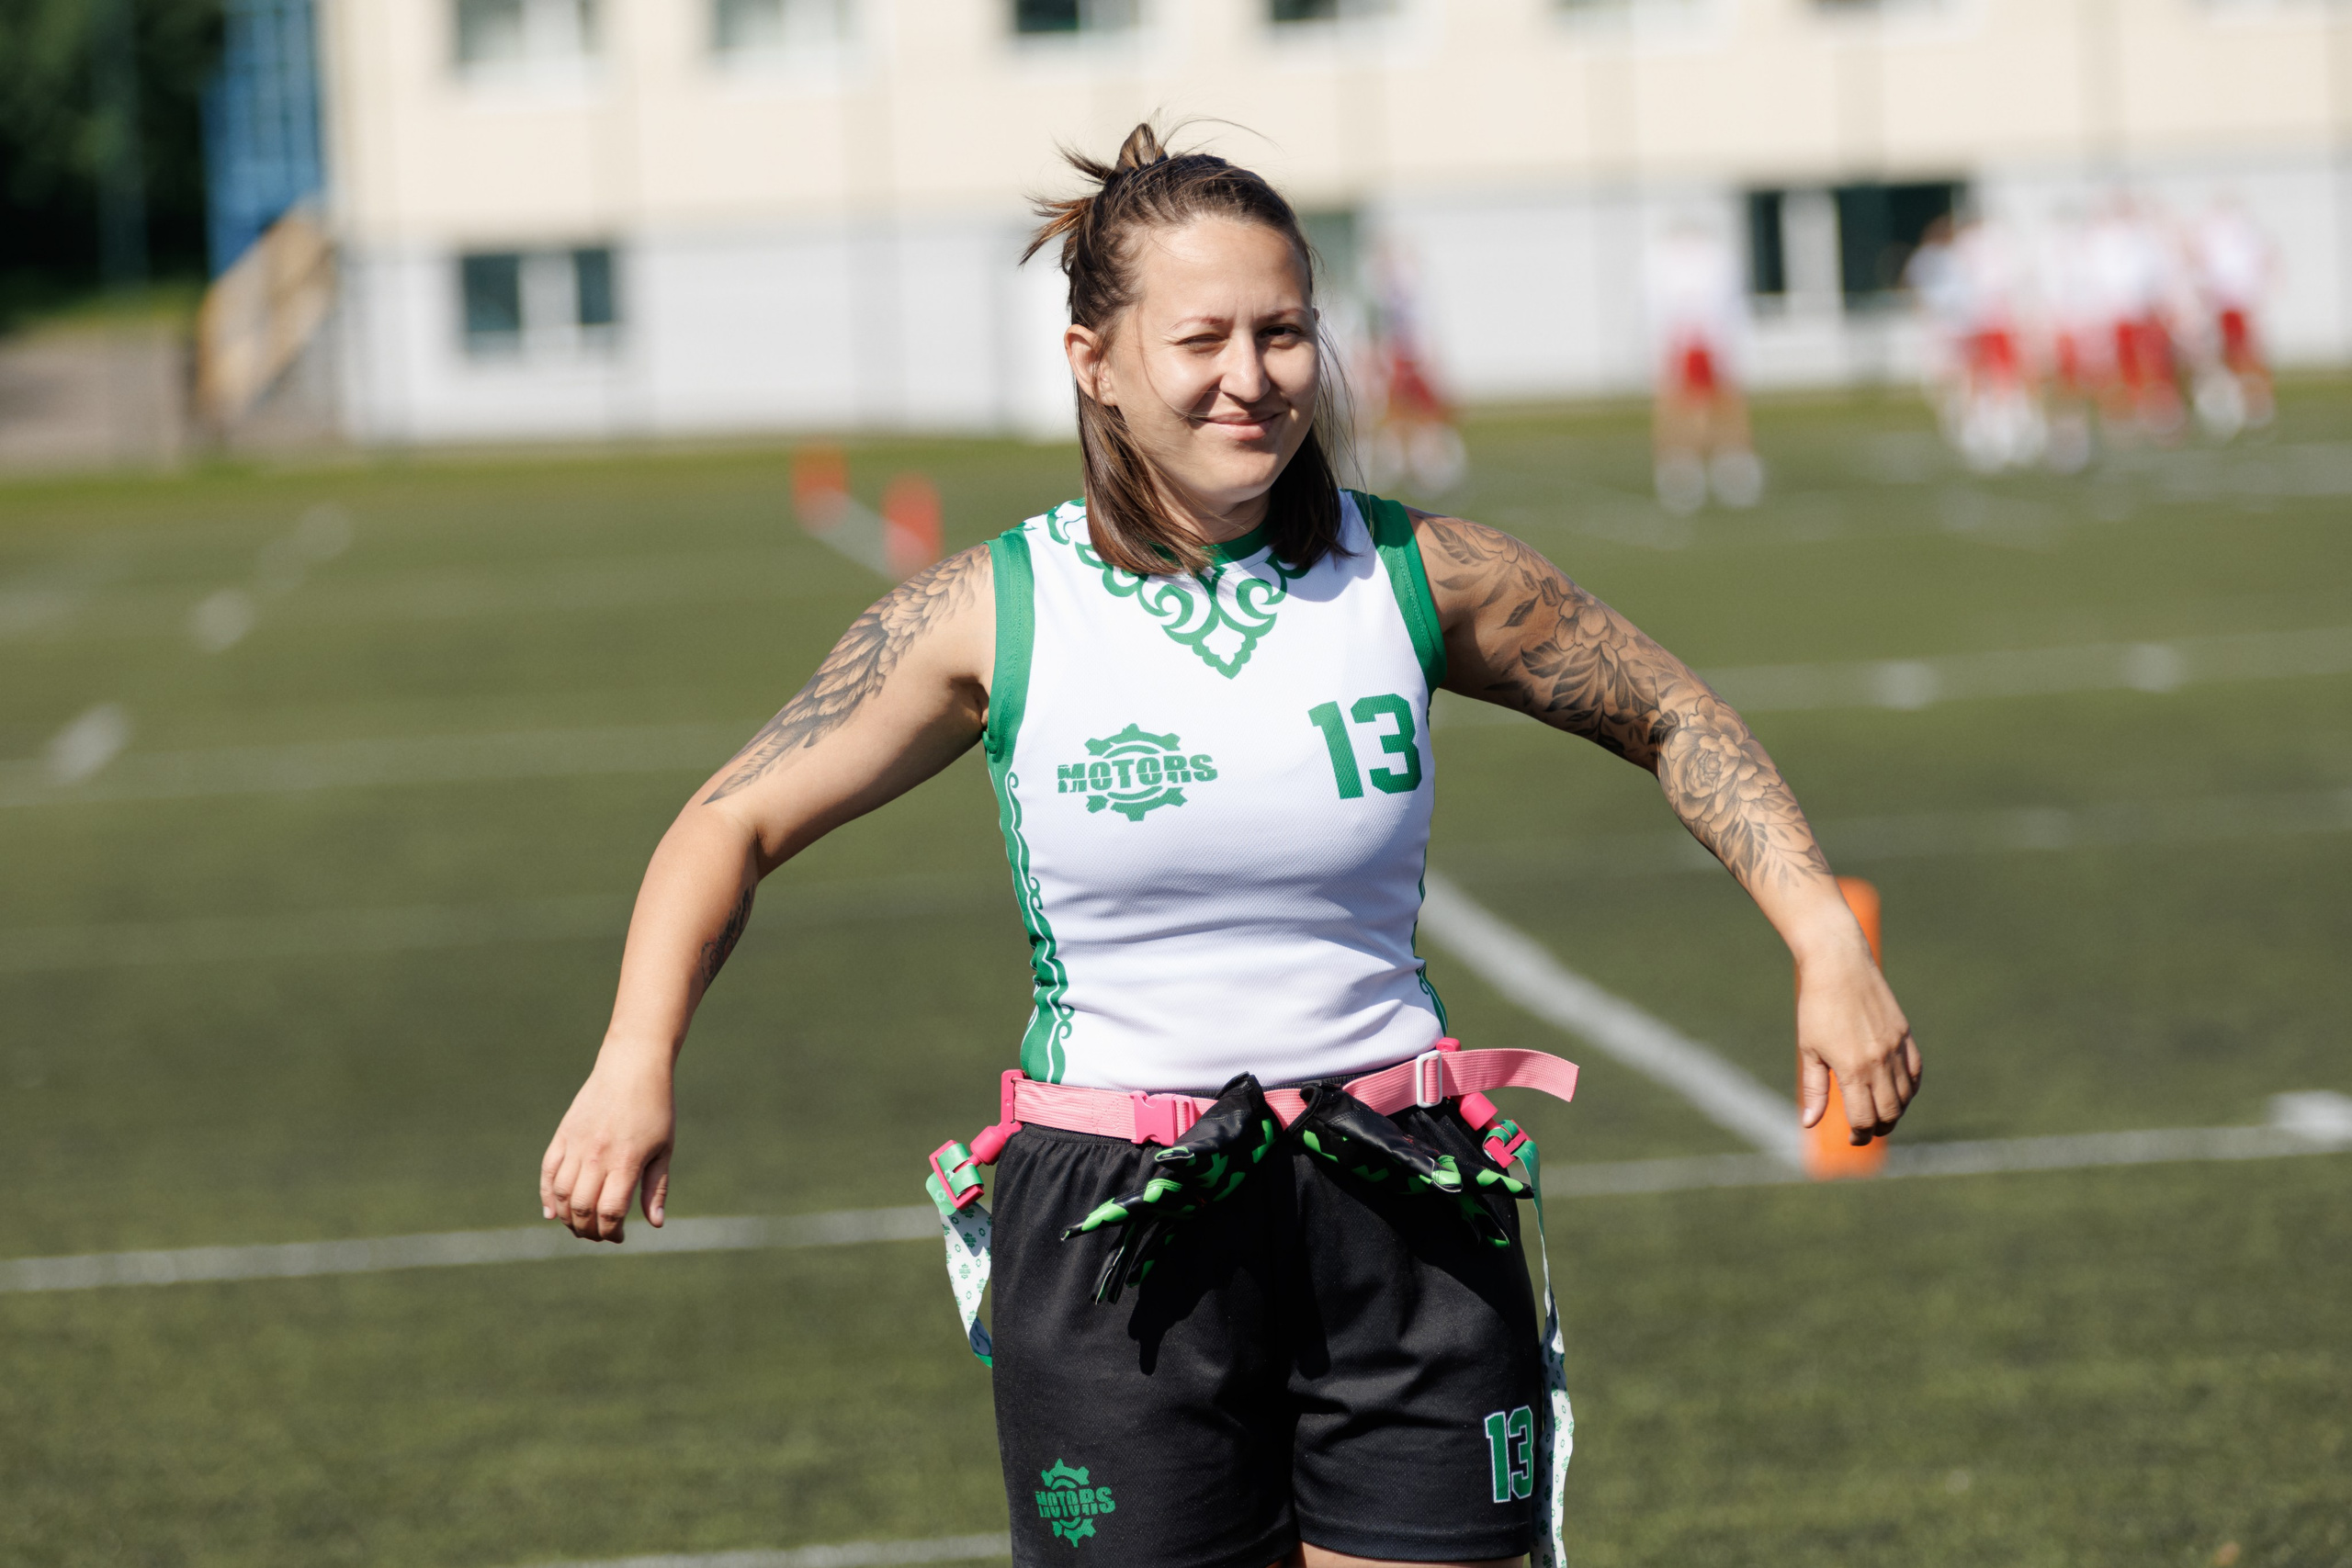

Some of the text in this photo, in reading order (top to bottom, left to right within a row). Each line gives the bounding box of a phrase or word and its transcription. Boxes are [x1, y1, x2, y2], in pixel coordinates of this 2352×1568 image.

[1057, 753, 1218, 794] MOTORS
[1307, 693, 1422, 799] 13
[1484, 1404, 1534, 1503] 13
[1035, 1486, 1116, 1518] MOTORS
